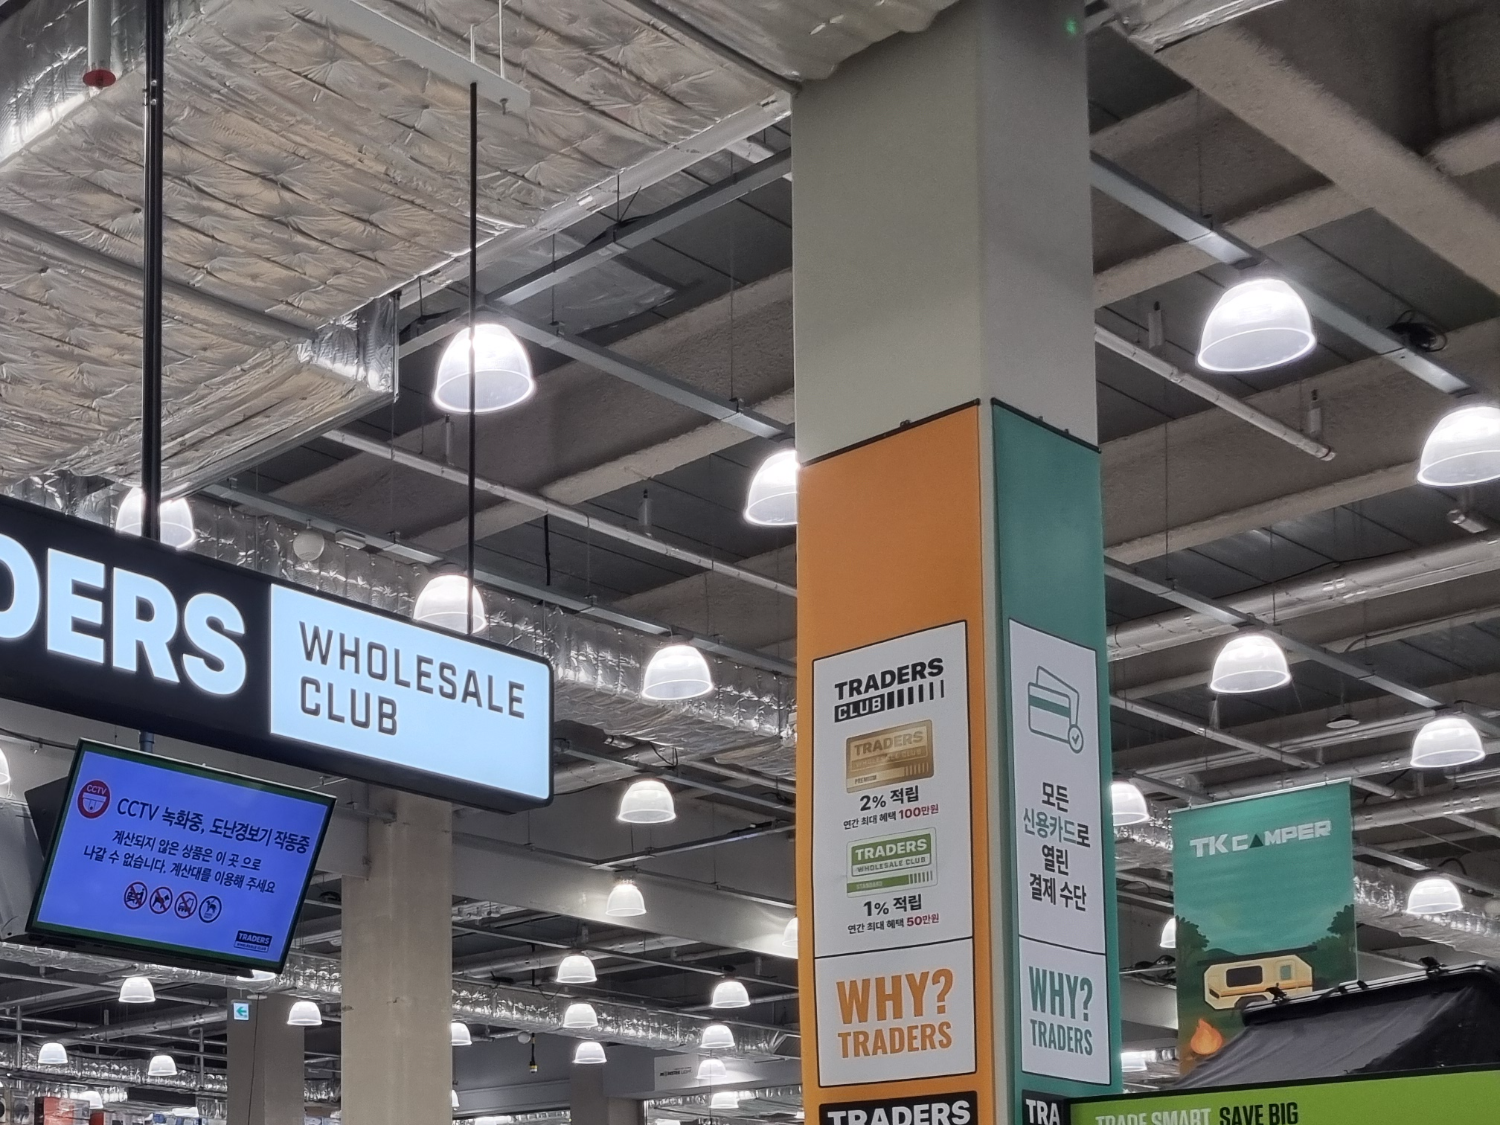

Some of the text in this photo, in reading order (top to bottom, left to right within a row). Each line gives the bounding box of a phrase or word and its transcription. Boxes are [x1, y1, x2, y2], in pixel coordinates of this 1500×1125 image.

[298, 620, 526, 720] WHOLESALE
[834, 657, 945, 701] TRADERS
[299, 675, 398, 737] CLUB
[837, 696, 883, 722] CLUB
[854, 729, 925, 757] TRADERS
[85, 783, 107, 796] CCTV
[854, 775, 877, 785] PREMIUM
[859, 784, 919, 812] 2% 적립
[1042, 781, 1069, 812] 모든
[116, 797, 311, 855] CCTV 녹화중, 도난경보기 작동중
[843, 803, 939, 831] 연간 최대 혜택 100만원
[1022, 807, 1091, 848] 신용카드로
[112, 829, 262, 872] 계산되지 않은 상품은 이 곳 으로
[855, 838, 928, 861] TRADERS
[1041, 844, 1069, 877] 열린
[1189, 833, 1229, 858] TK
[83, 846, 276, 895] 나갈 수 없습니다. 계산대를 이용해 주세요
[857, 855, 926, 873] WHOLESALE CLUB
[863, 893, 922, 918] 1% 적립
[1029, 872, 1087, 912] 결제 수단
[238, 932, 271, 945] TRADERS
[847, 912, 940, 935] 연간 최대 혜택 50만원
[836, 968, 954, 1025] WHY?
[1028, 965, 1093, 1022] WHY?
[837, 1021, 953, 1059] TRADERS
[1029, 1018, 1093, 1056] TRADERS
[1269, 1102, 1299, 1125] BIG
